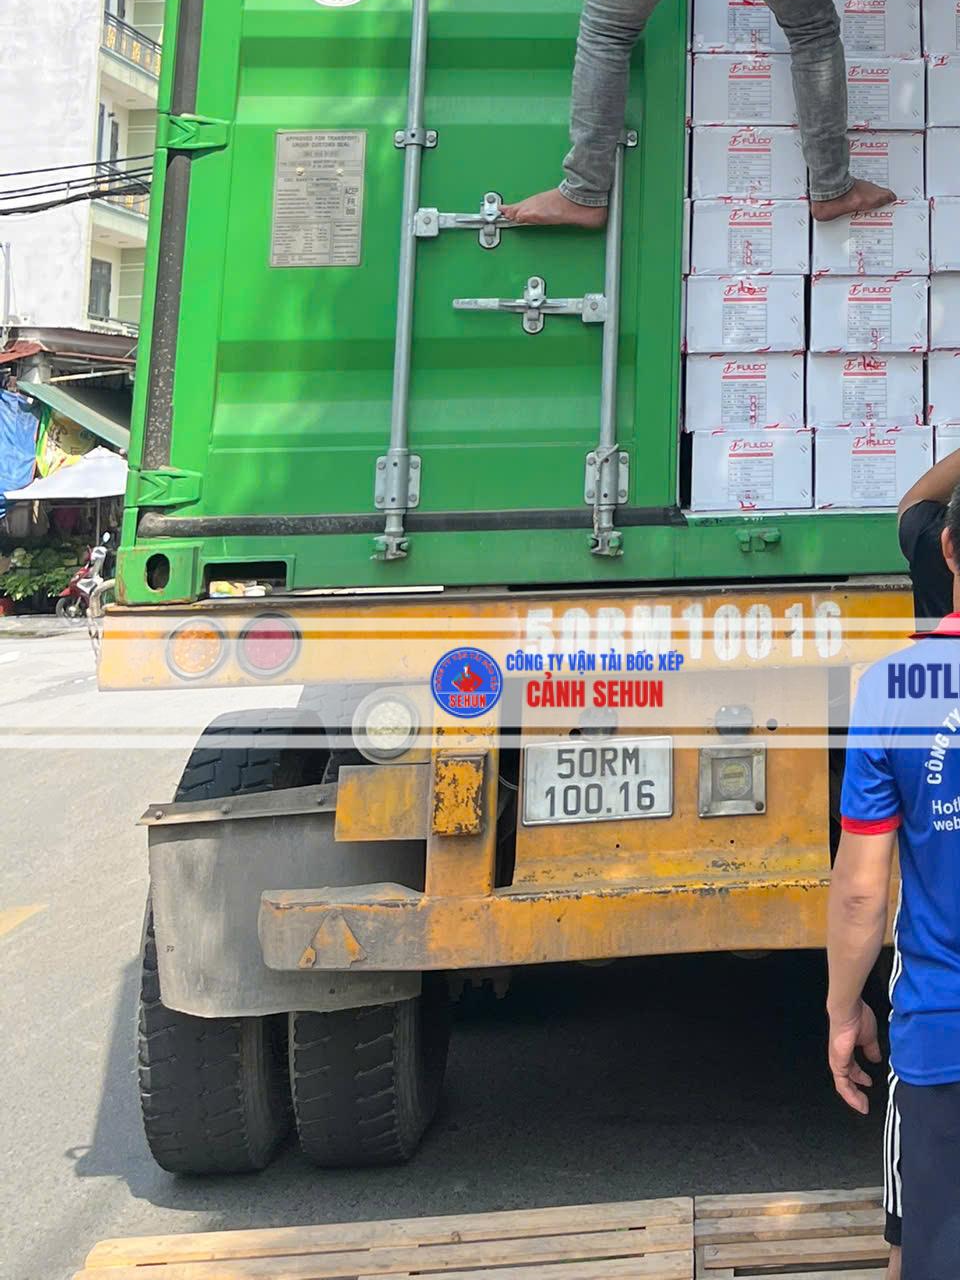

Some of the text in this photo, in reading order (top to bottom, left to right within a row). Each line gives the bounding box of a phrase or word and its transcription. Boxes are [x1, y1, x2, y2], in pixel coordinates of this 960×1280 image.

[557, 746, 641, 779] 50RM
[926, 733, 951, 785] CÔNG
[545, 779, 656, 817] 100.16
